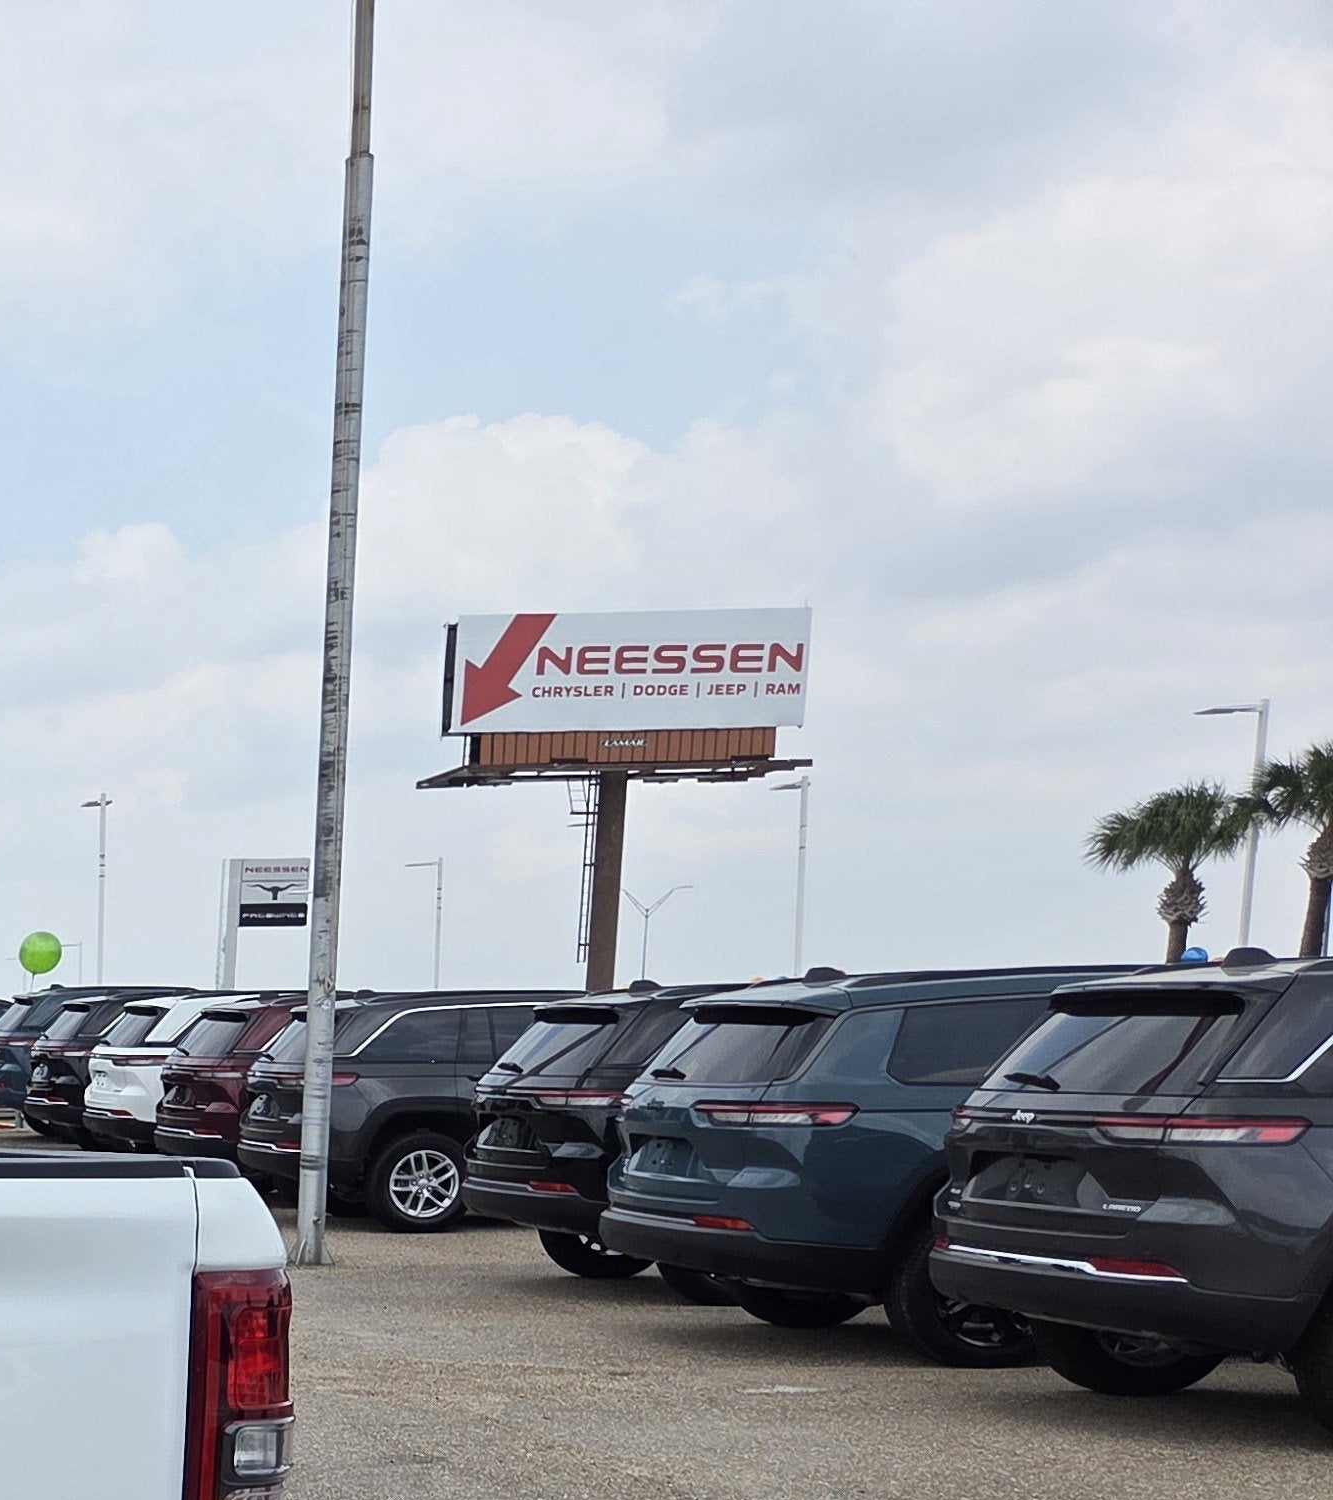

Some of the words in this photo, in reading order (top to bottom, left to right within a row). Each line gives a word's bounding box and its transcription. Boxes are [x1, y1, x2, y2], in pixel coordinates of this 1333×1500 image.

[536, 643, 805, 676] NEESSEN
[532, 684, 615, 698] CHRYSLER
[633, 684, 689, 697] DODGE
[707, 683, 747, 697] JEEP
[765, 682, 802, 696] RAM
[603, 738, 646, 747] LAMAR
